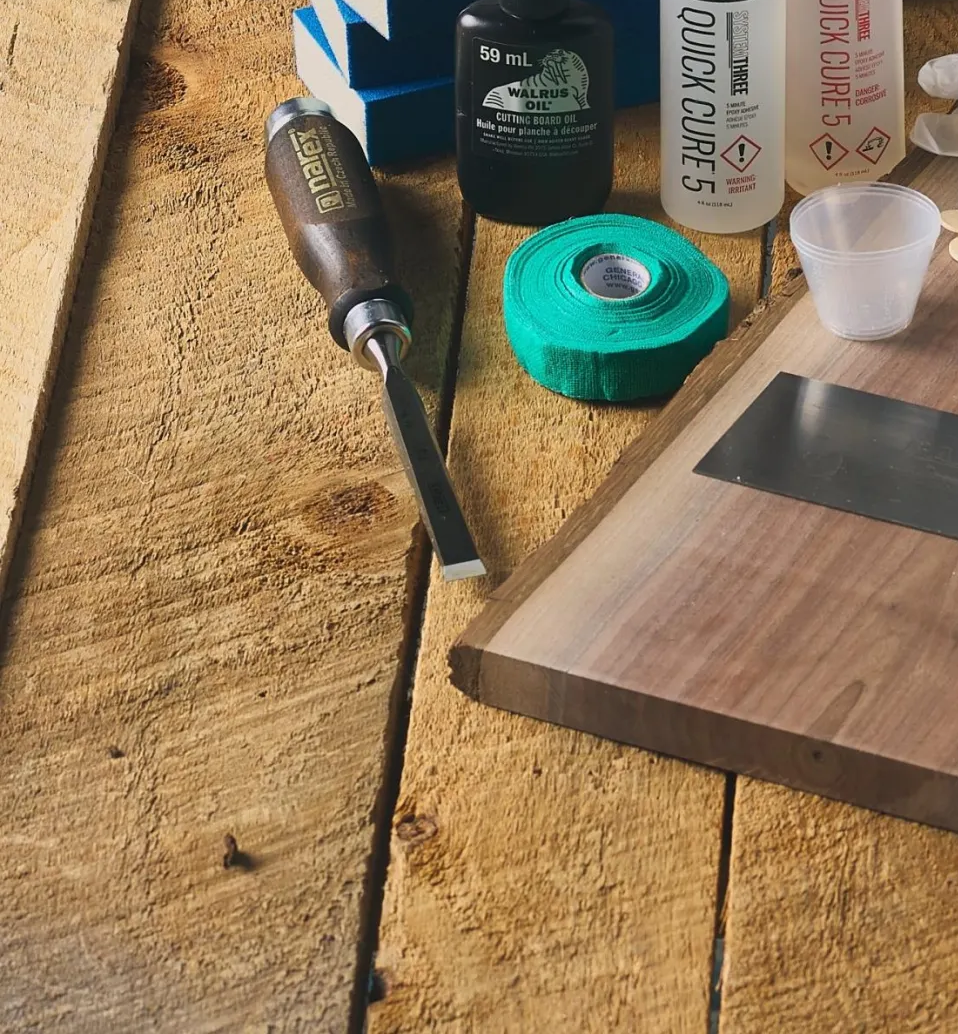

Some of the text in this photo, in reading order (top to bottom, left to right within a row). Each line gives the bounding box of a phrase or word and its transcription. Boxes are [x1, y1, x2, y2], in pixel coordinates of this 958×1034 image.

[480, 45, 533, 67] 59 mL
[820, 51, 851, 109] CURE
[507, 87, 569, 99] WALRUS
[677, 6, 716, 194] QUICK CURE 5
[525, 100, 550, 111] OIL
[496, 112, 578, 125] CUTTING BOARD OIL
[821, 114, 851, 127] 5
[476, 118, 496, 131] Huile
[498, 125, 517, 135] pour
[519, 127, 551, 136] planche
[561, 122, 598, 135] découper
[294, 127, 334, 194] narex
[728, 182, 756, 194] IRRITANT
[602, 274, 643, 288] CHICAGO
